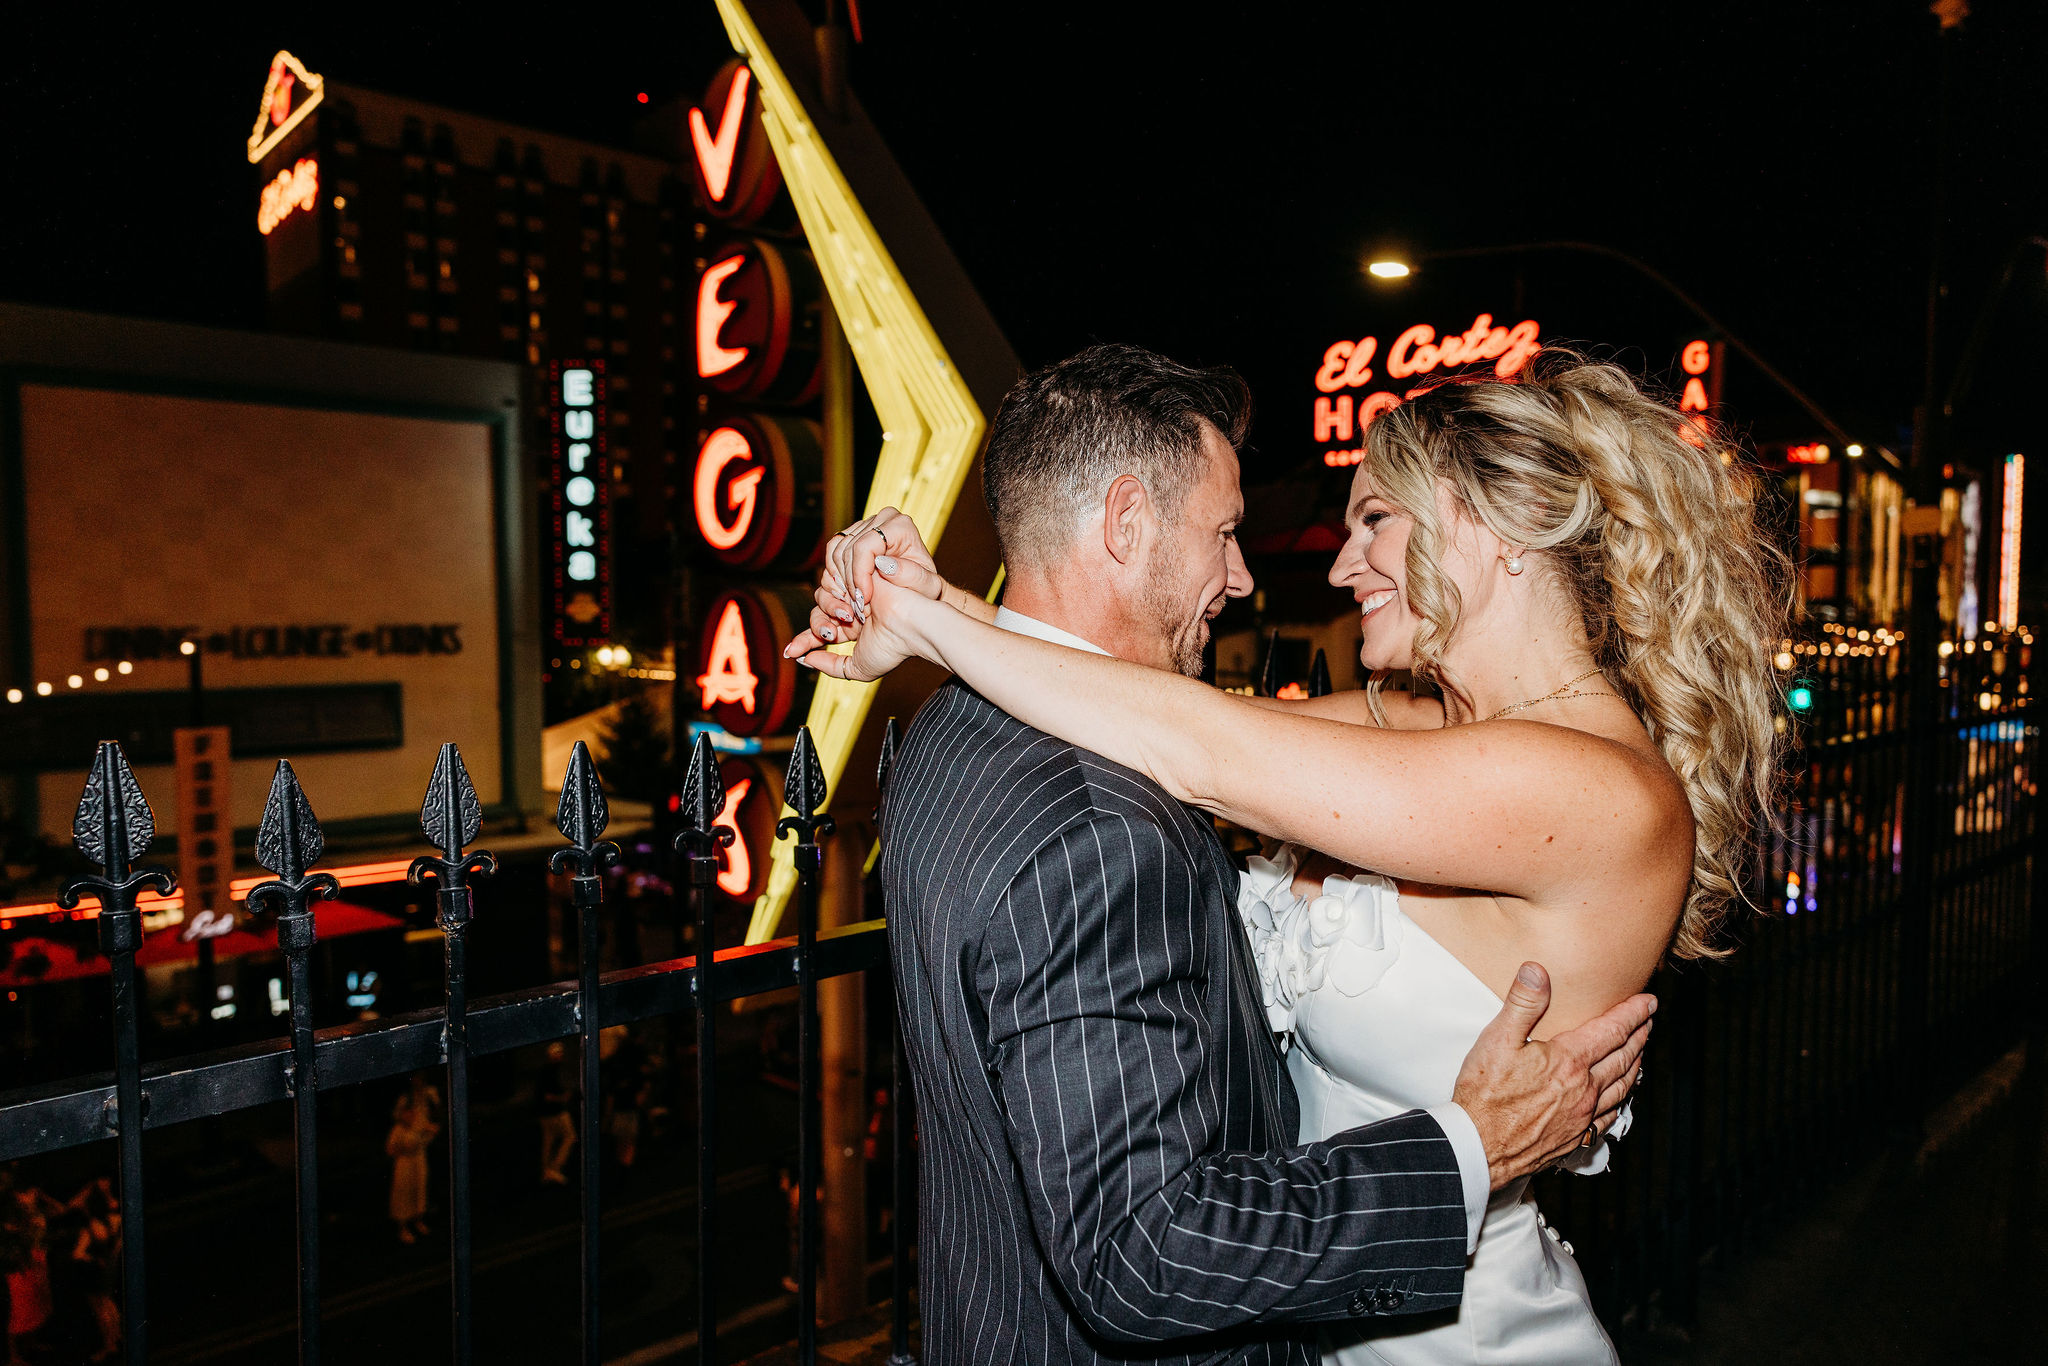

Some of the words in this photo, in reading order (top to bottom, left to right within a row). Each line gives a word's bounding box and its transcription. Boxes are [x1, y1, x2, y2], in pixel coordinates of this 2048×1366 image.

[689, 66, 766, 894] VEGAS
[1315, 336, 1377, 393] El
[1386, 313, 1541, 379] Cortez
